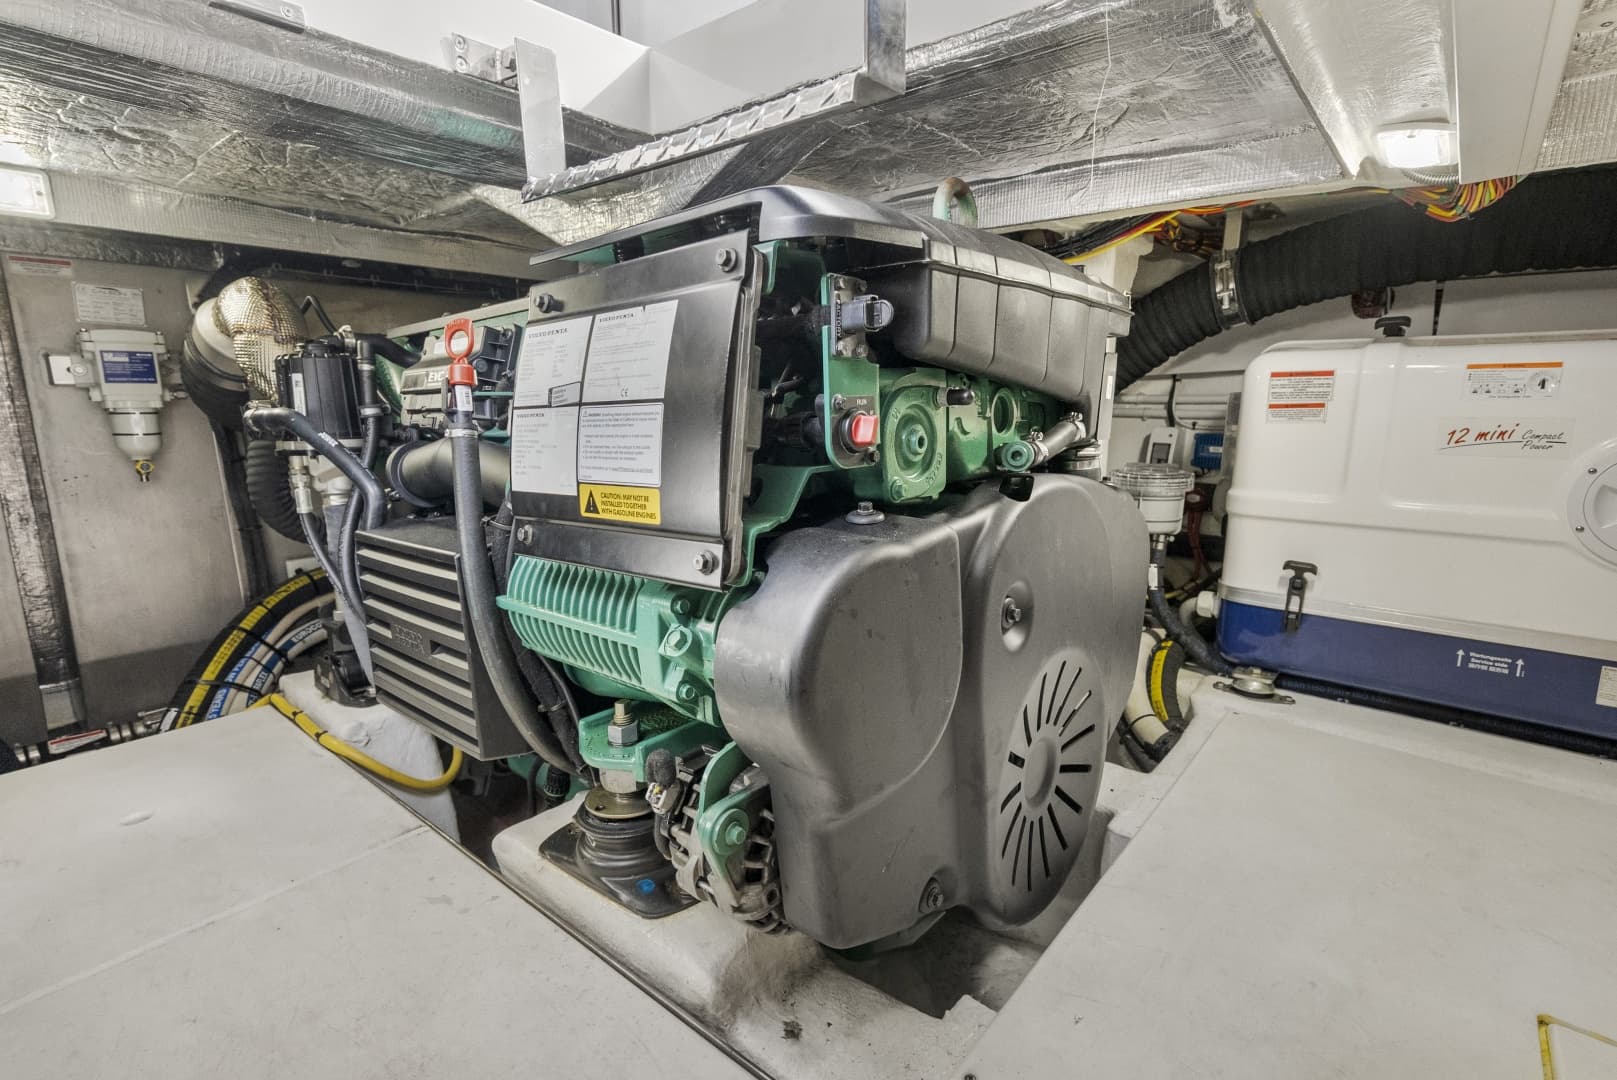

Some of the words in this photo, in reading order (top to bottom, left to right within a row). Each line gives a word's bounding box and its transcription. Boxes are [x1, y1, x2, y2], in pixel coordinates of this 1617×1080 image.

[1447, 427, 1470, 446] 12
[1474, 423, 1520, 442] mini
[1521, 429, 1564, 441] Compact
[1521, 440, 1554, 450] Power
[633, 494, 643, 502] NOT
[601, 500, 623, 508] INSTALLED
[624, 501, 647, 510] TOGETHER
[613, 508, 635, 518] GASOLINE
[635, 511, 657, 520] ENGINES
[1470, 657, 1494, 666] Service
